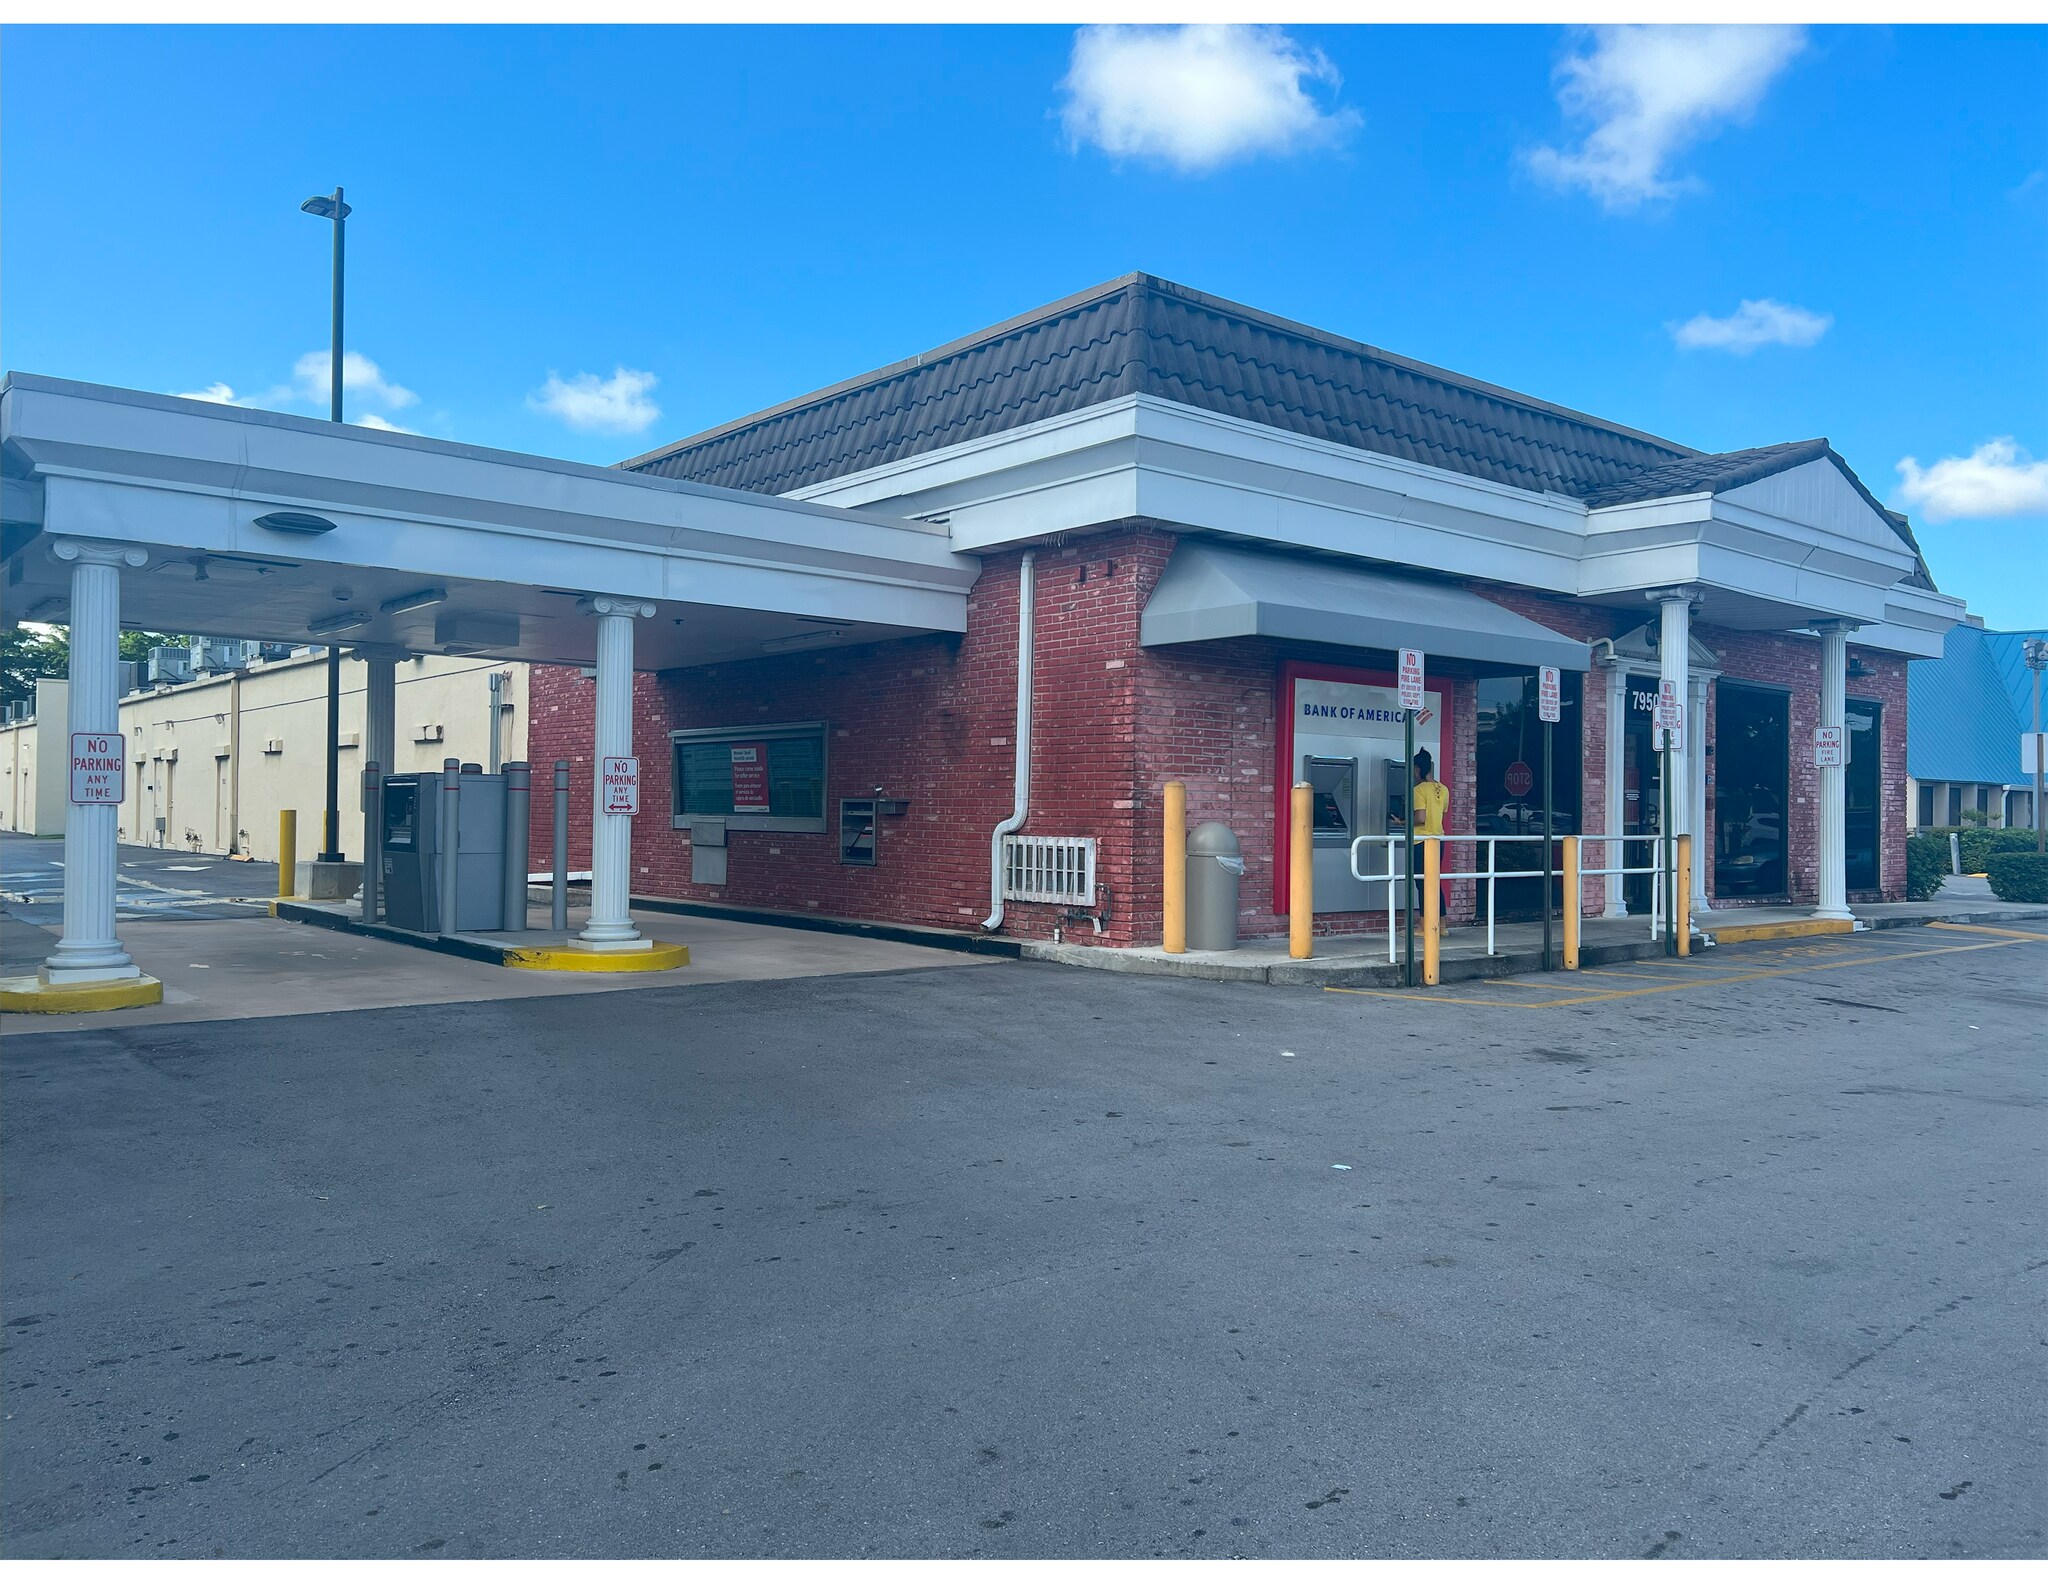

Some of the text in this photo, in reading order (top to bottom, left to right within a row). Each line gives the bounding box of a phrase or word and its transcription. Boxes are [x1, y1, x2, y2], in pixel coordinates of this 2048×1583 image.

[1406, 654, 1416, 666] NO
[1402, 666, 1420, 675] PARKING
[1411, 675, 1421, 684] LANE
[1546, 671, 1553, 682] NO
[1542, 682, 1557, 691] PARKING
[1633, 691, 1659, 711] 7950
[1304, 704, 1337, 718] BANK
[1340, 707, 1355, 719] OF
[88, 740, 107, 753] NO
[1816, 740, 1840, 748] PARKING
[74, 758, 121, 771] PARKING
[614, 762, 628, 773] NO
[87, 775, 108, 784] ANY
[605, 775, 636, 785] PARKING
[85, 788, 110, 797] TIME
